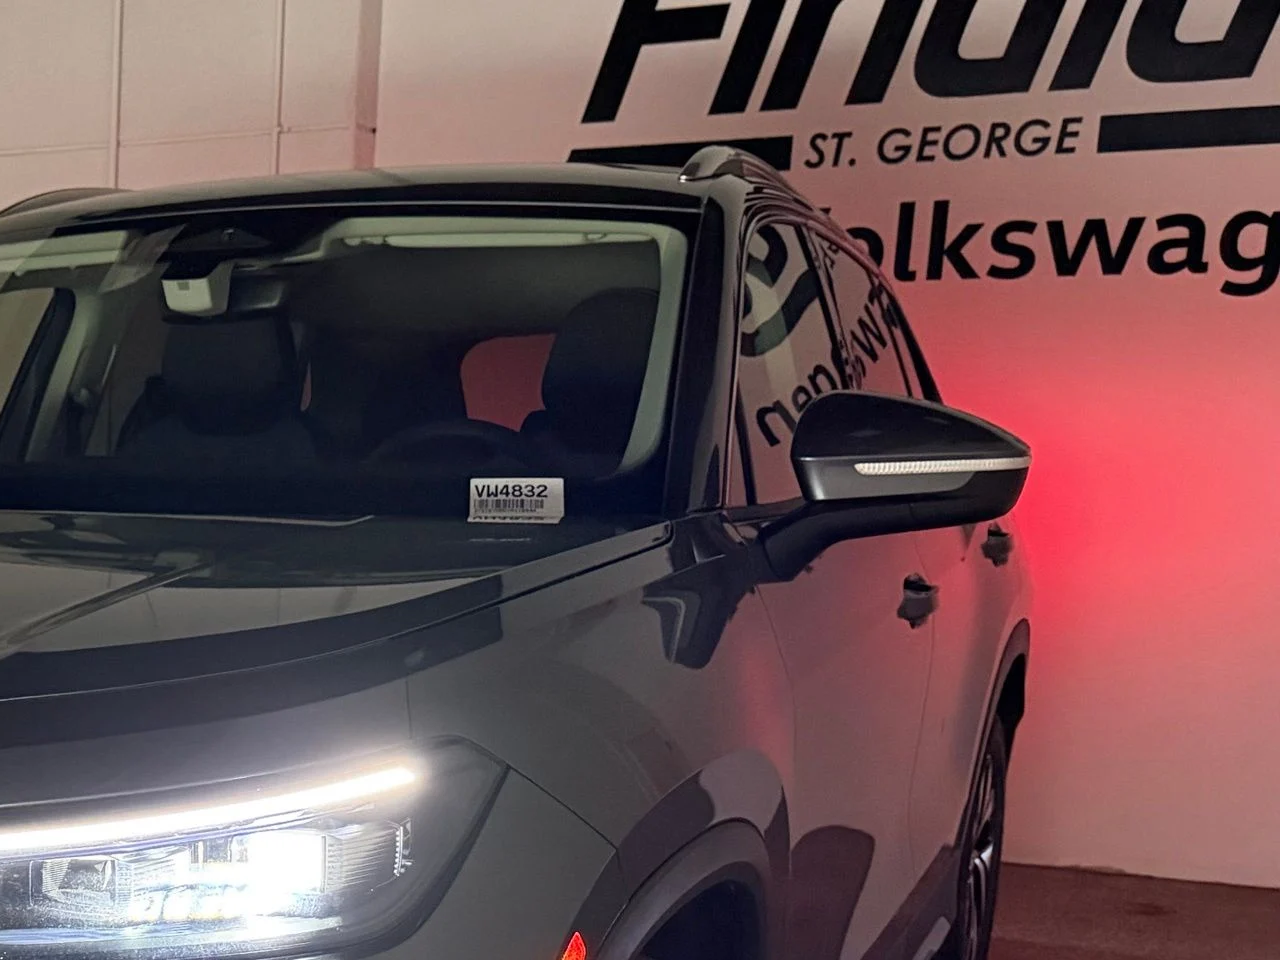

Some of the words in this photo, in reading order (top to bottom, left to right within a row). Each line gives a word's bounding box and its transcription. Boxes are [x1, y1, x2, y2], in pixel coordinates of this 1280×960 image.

[804, 131, 856, 169] ST.
[877, 117, 1084, 165] GEORGE
[474, 484, 549, 498] VW4832
